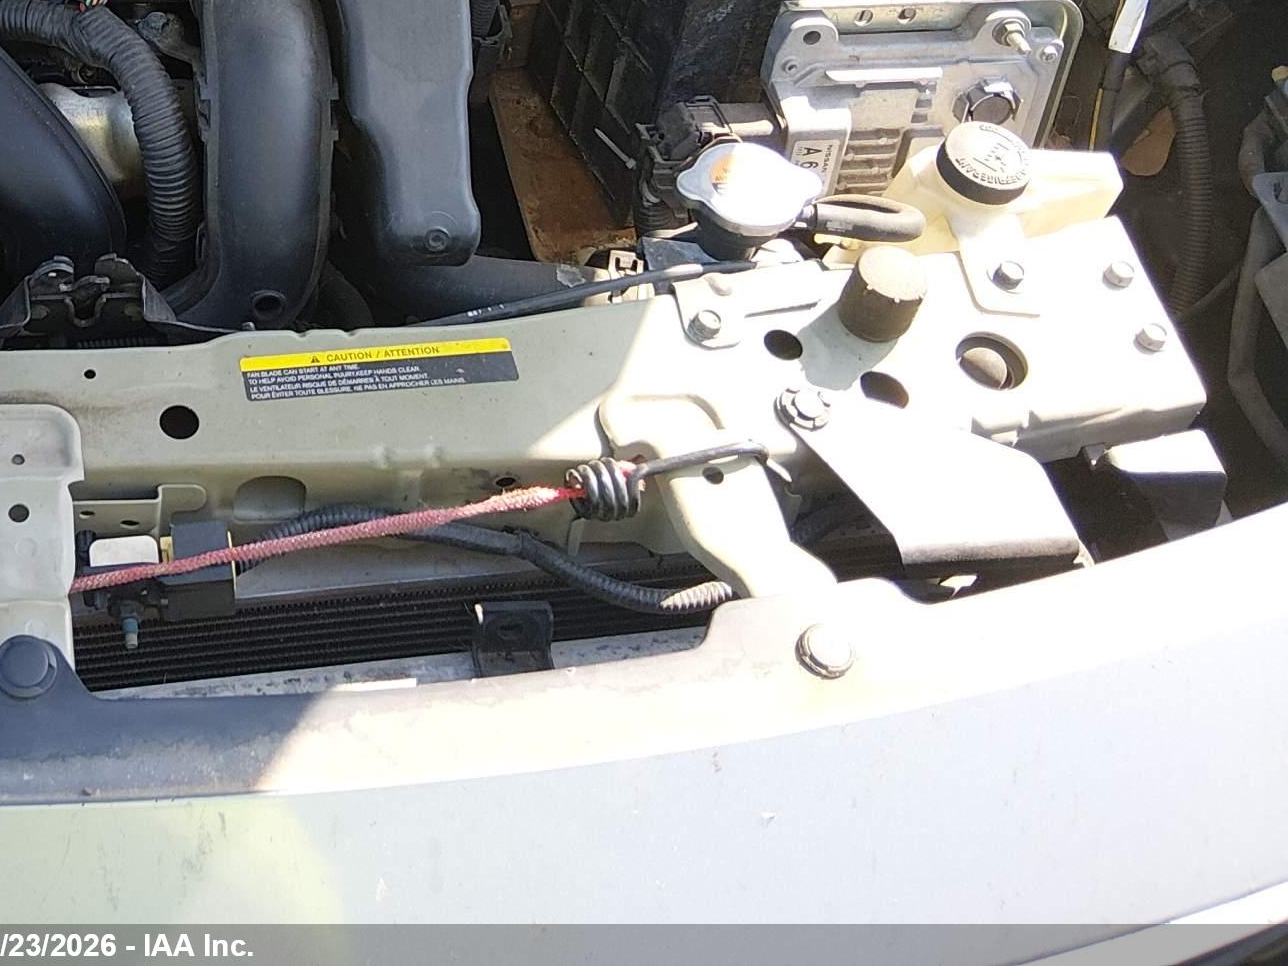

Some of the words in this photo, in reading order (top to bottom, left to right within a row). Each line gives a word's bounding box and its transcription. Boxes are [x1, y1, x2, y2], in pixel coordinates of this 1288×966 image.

[821, 144, 834, 173] NISSAN
[326, 351, 372, 362] CAUTION
[384, 346, 440, 358] ATTENTION
[259, 377, 275, 385] HELP
[277, 375, 297, 384] AVOID
[298, 373, 332, 382] PERSONAL
[283, 368, 298, 376] CAN
[381, 374, 398, 382] TOUT
[251, 391, 270, 400] POUR
[364, 383, 378, 391] PAS
[379, 382, 388, 390] EN
[388, 379, 430, 389] APPROCHER
[430, 378, 443, 386] LES
